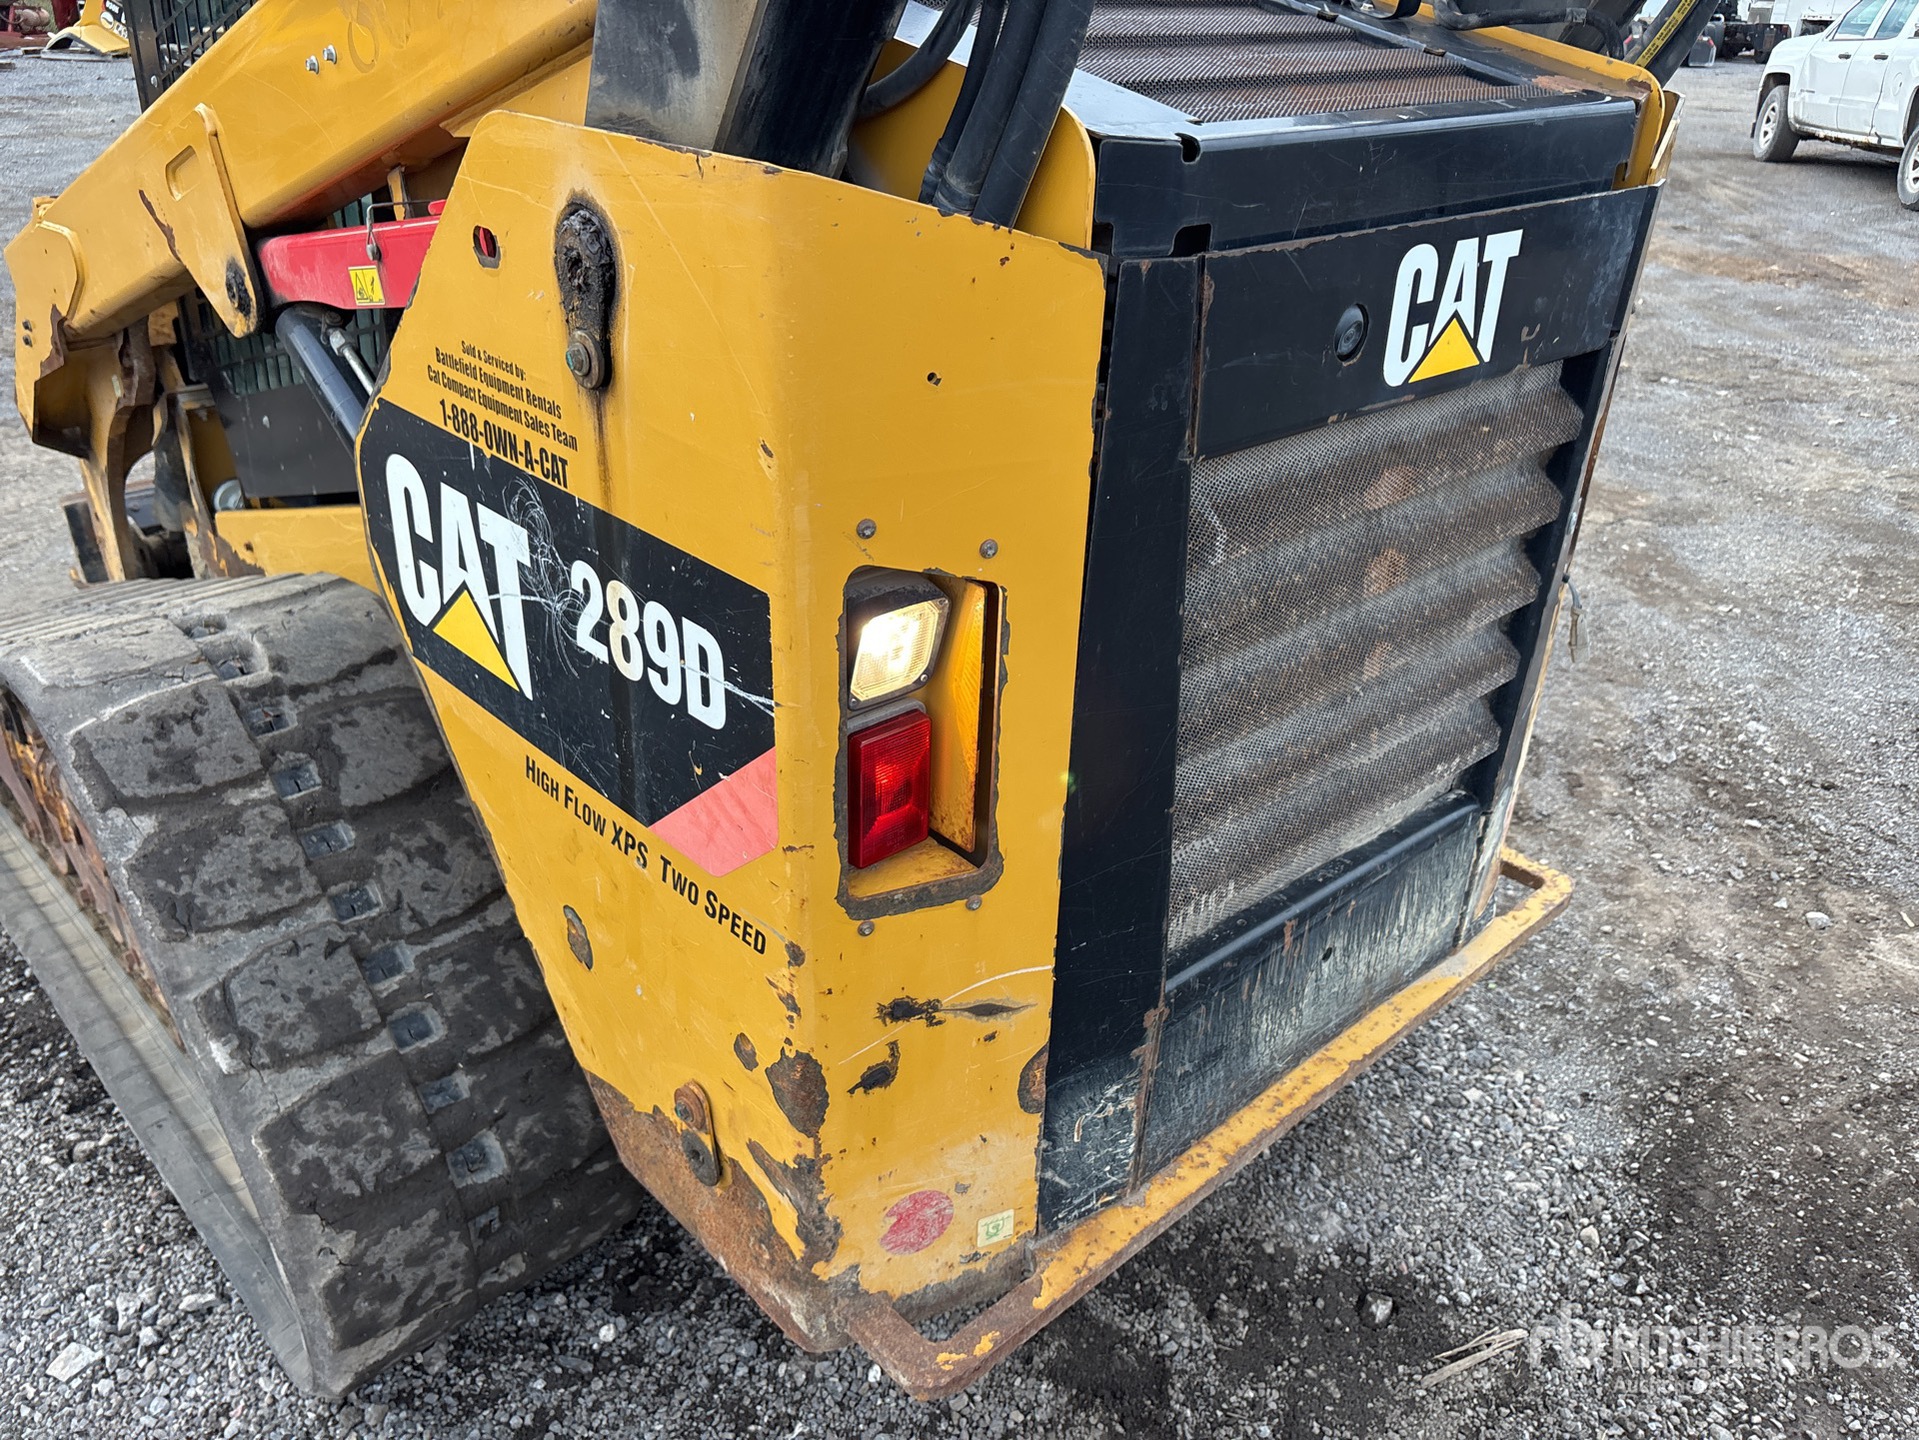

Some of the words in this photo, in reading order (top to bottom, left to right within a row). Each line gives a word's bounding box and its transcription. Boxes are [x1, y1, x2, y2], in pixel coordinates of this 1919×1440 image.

[1382, 229, 1524, 388] CAT
[435, 346, 478, 381] Battlefield
[479, 366, 525, 403] Equipment
[526, 388, 562, 420] Rentals
[461, 340, 477, 359] Sold
[478, 349, 483, 361] &
[483, 350, 514, 376] Serviced
[515, 364, 527, 381] by:
[427, 364, 442, 386] Cat
[441, 371, 477, 404] Compact
[477, 388, 524, 426] Equipment
[523, 410, 551, 438] Sales
[551, 423, 579, 452] Team
[439, 398, 569, 489] 1-888-OWN-A-CAT
[386, 453, 533, 701] CAT
[570, 559, 727, 730] 289D
[611, 820, 650, 870] XPS
